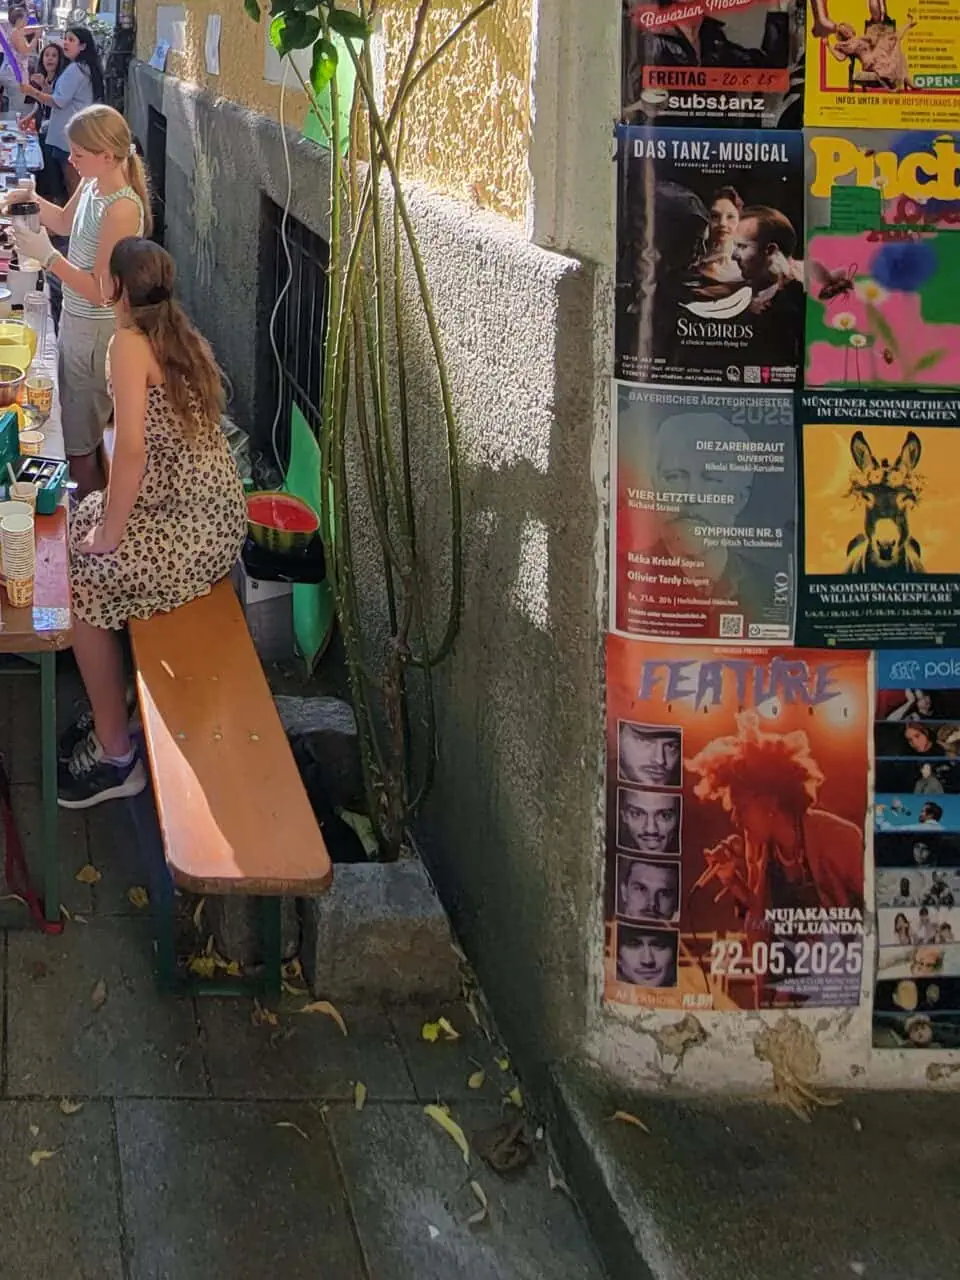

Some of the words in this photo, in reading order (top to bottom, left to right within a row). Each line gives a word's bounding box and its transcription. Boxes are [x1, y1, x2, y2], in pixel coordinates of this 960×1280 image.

[641, 4, 704, 27] Bavarian
[648, 71, 706, 87] FREITAG
[668, 92, 765, 110] substanz
[634, 139, 666, 159] DAS
[671, 140, 789, 162] TANZ-MUSICAL
[676, 318, 754, 339] SKYBIRDS
[628, 391, 699, 405] BAYERISCHES
[701, 394, 790, 407] ÄRZTEORCHESTER
[802, 396, 866, 407] MÜNCHNER
[817, 407, 831, 416] IM
[834, 407, 907, 418] ENGLISCHEN
[910, 410, 957, 420] GARTEN
[696, 440, 713, 450] DIE
[715, 441, 784, 452] ZARENBRAUT
[627, 488, 655, 501] VIER
[656, 492, 696, 503] LETZTE
[697, 494, 734, 504] LIEDER
[694, 526, 754, 537] SYMPHONIE
[627, 570, 657, 583] Olivier
[808, 584, 827, 593] EIN
[820, 593, 869, 603] WILLIAM
[872, 592, 952, 602] SHAKESPEARE
[638, 657, 842, 709] FEATURE
[764, 908, 863, 922] NUJAKASHA
[774, 922, 865, 935] KI'LUANDA
[710, 941, 862, 976] 22.05.2025
